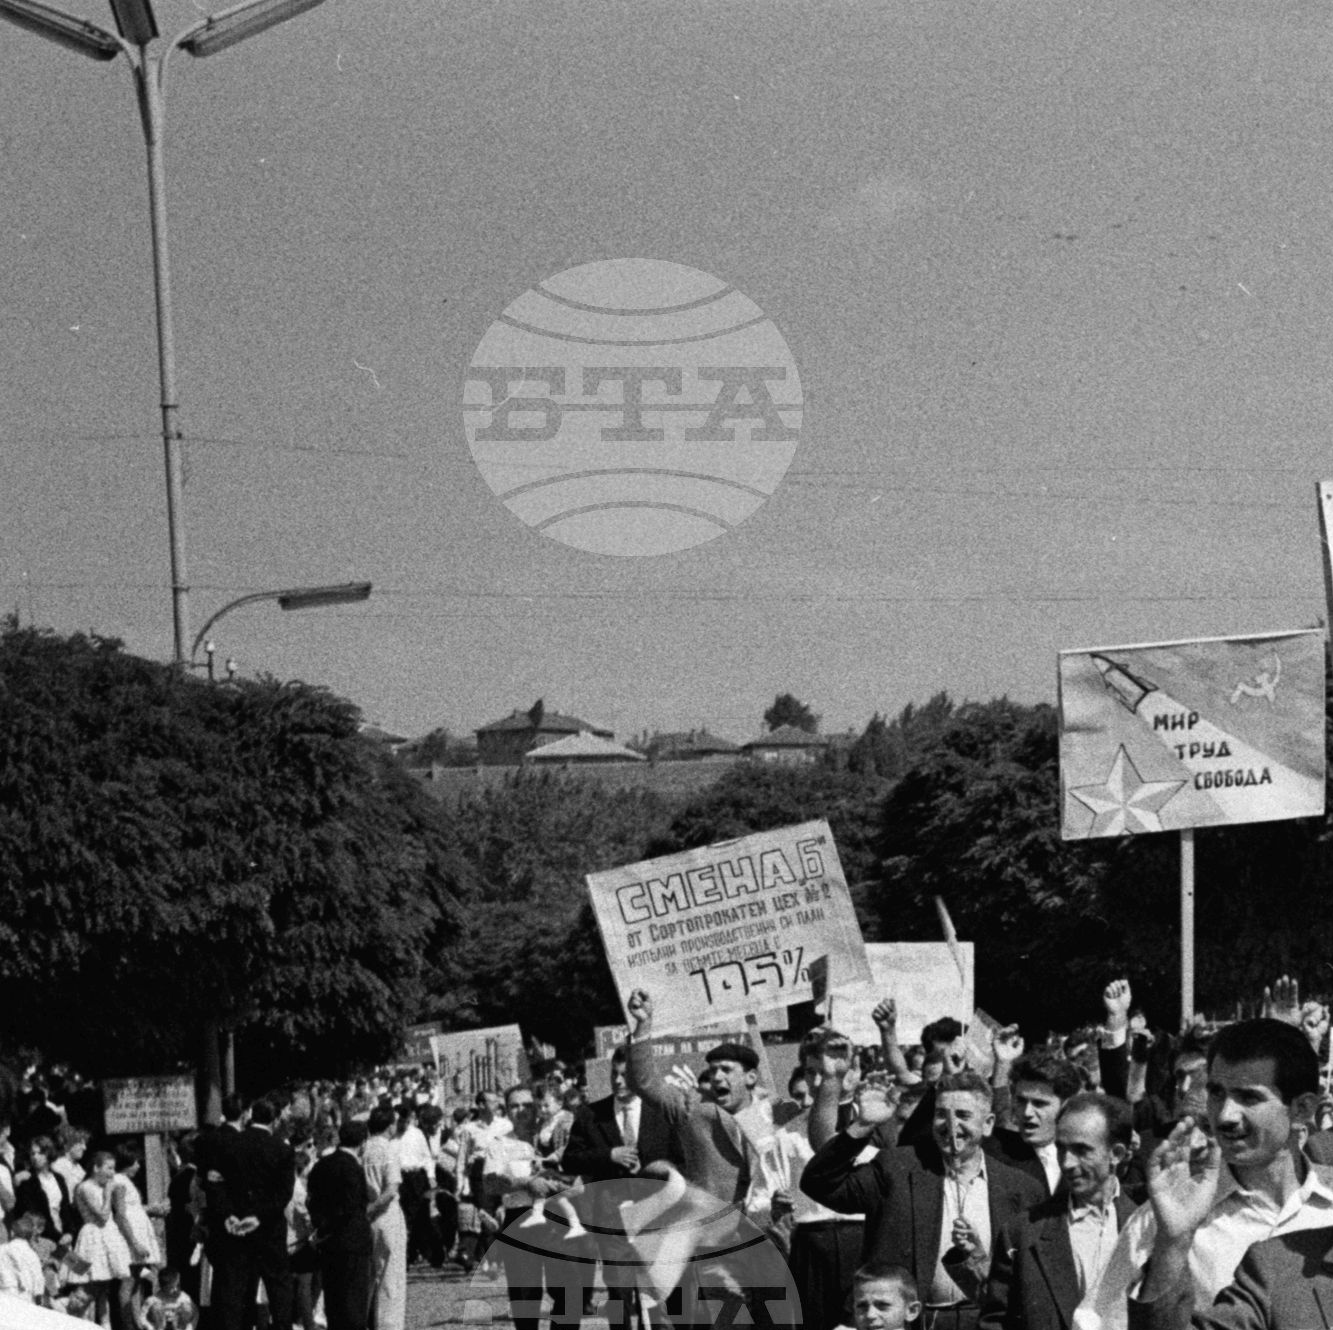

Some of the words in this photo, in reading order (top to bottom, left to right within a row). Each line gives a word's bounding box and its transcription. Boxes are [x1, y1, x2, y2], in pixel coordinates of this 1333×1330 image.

[1153, 711, 1200, 731] МИР
[1174, 741, 1232, 760] ТРУД
[616, 848, 796, 924] СМЕНА
[773, 892, 800, 912] ЦЕХ
